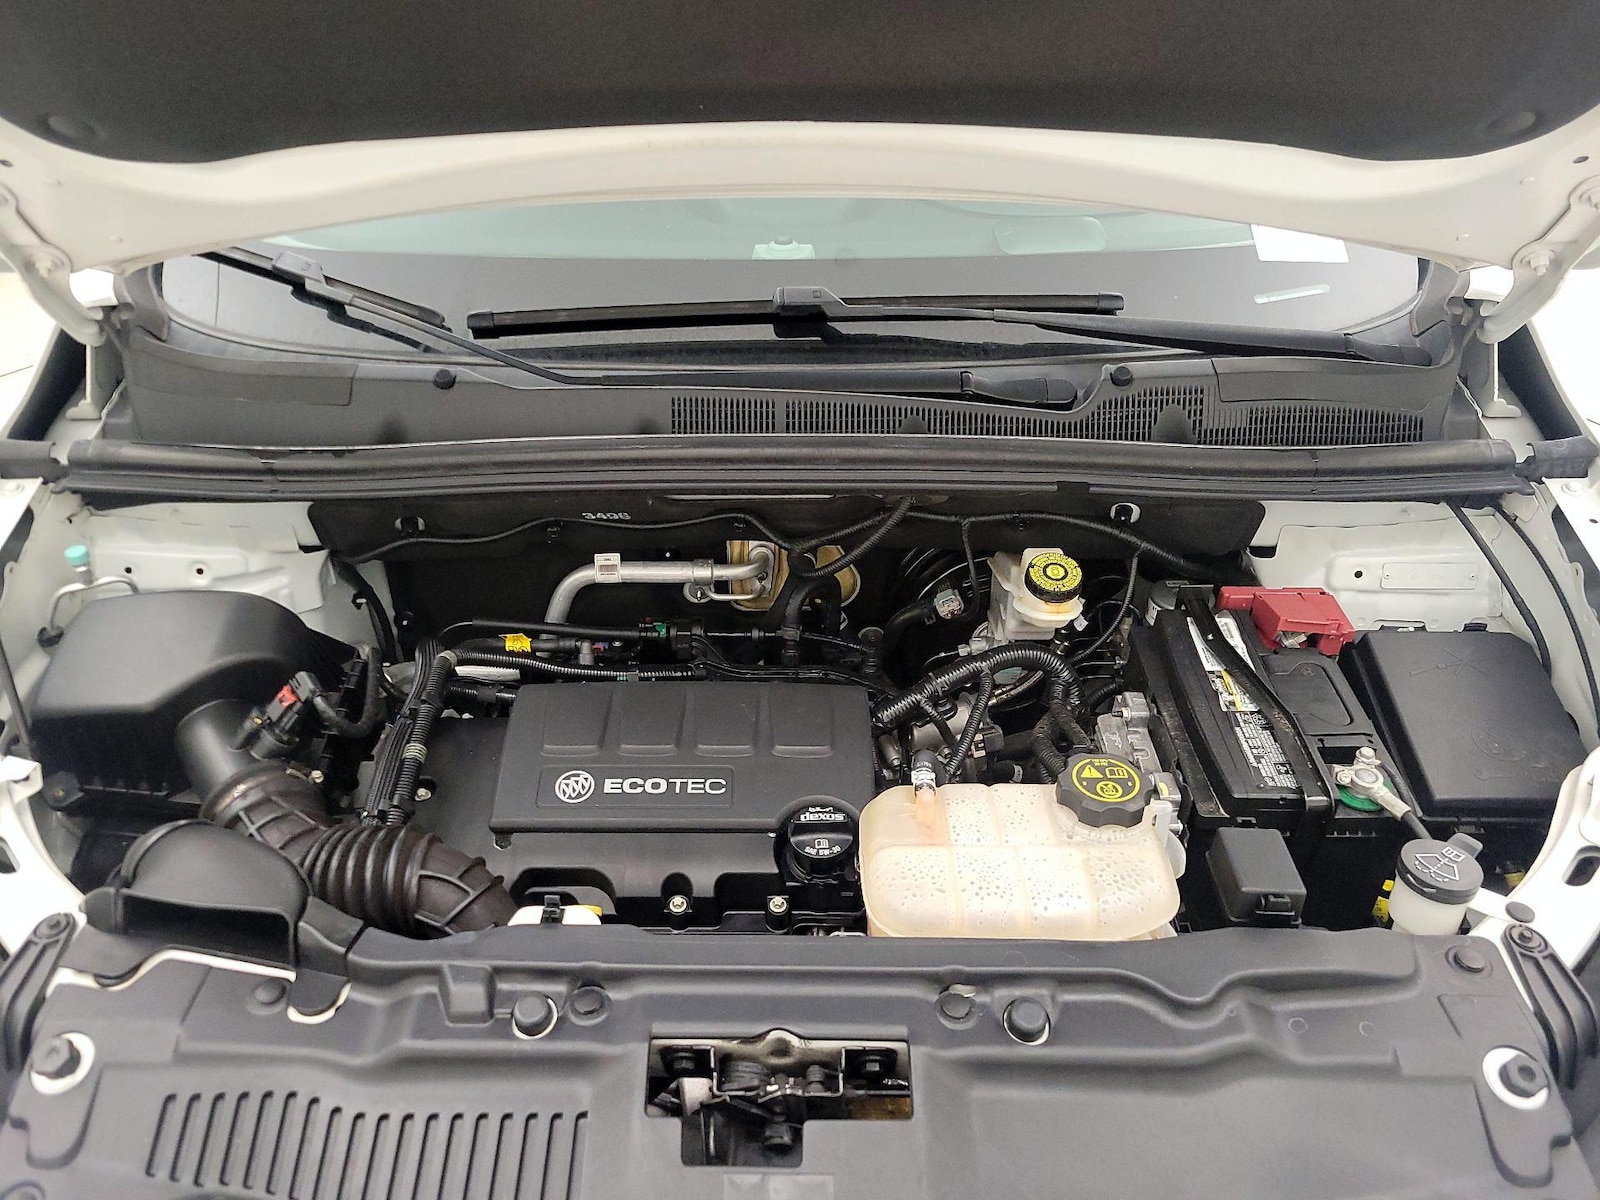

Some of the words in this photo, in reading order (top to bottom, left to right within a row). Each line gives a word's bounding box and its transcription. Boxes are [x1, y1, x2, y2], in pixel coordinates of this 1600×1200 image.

[603, 778, 727, 794] ECOTEC
[800, 812, 846, 822] dexos
[804, 846, 818, 856] SAE
